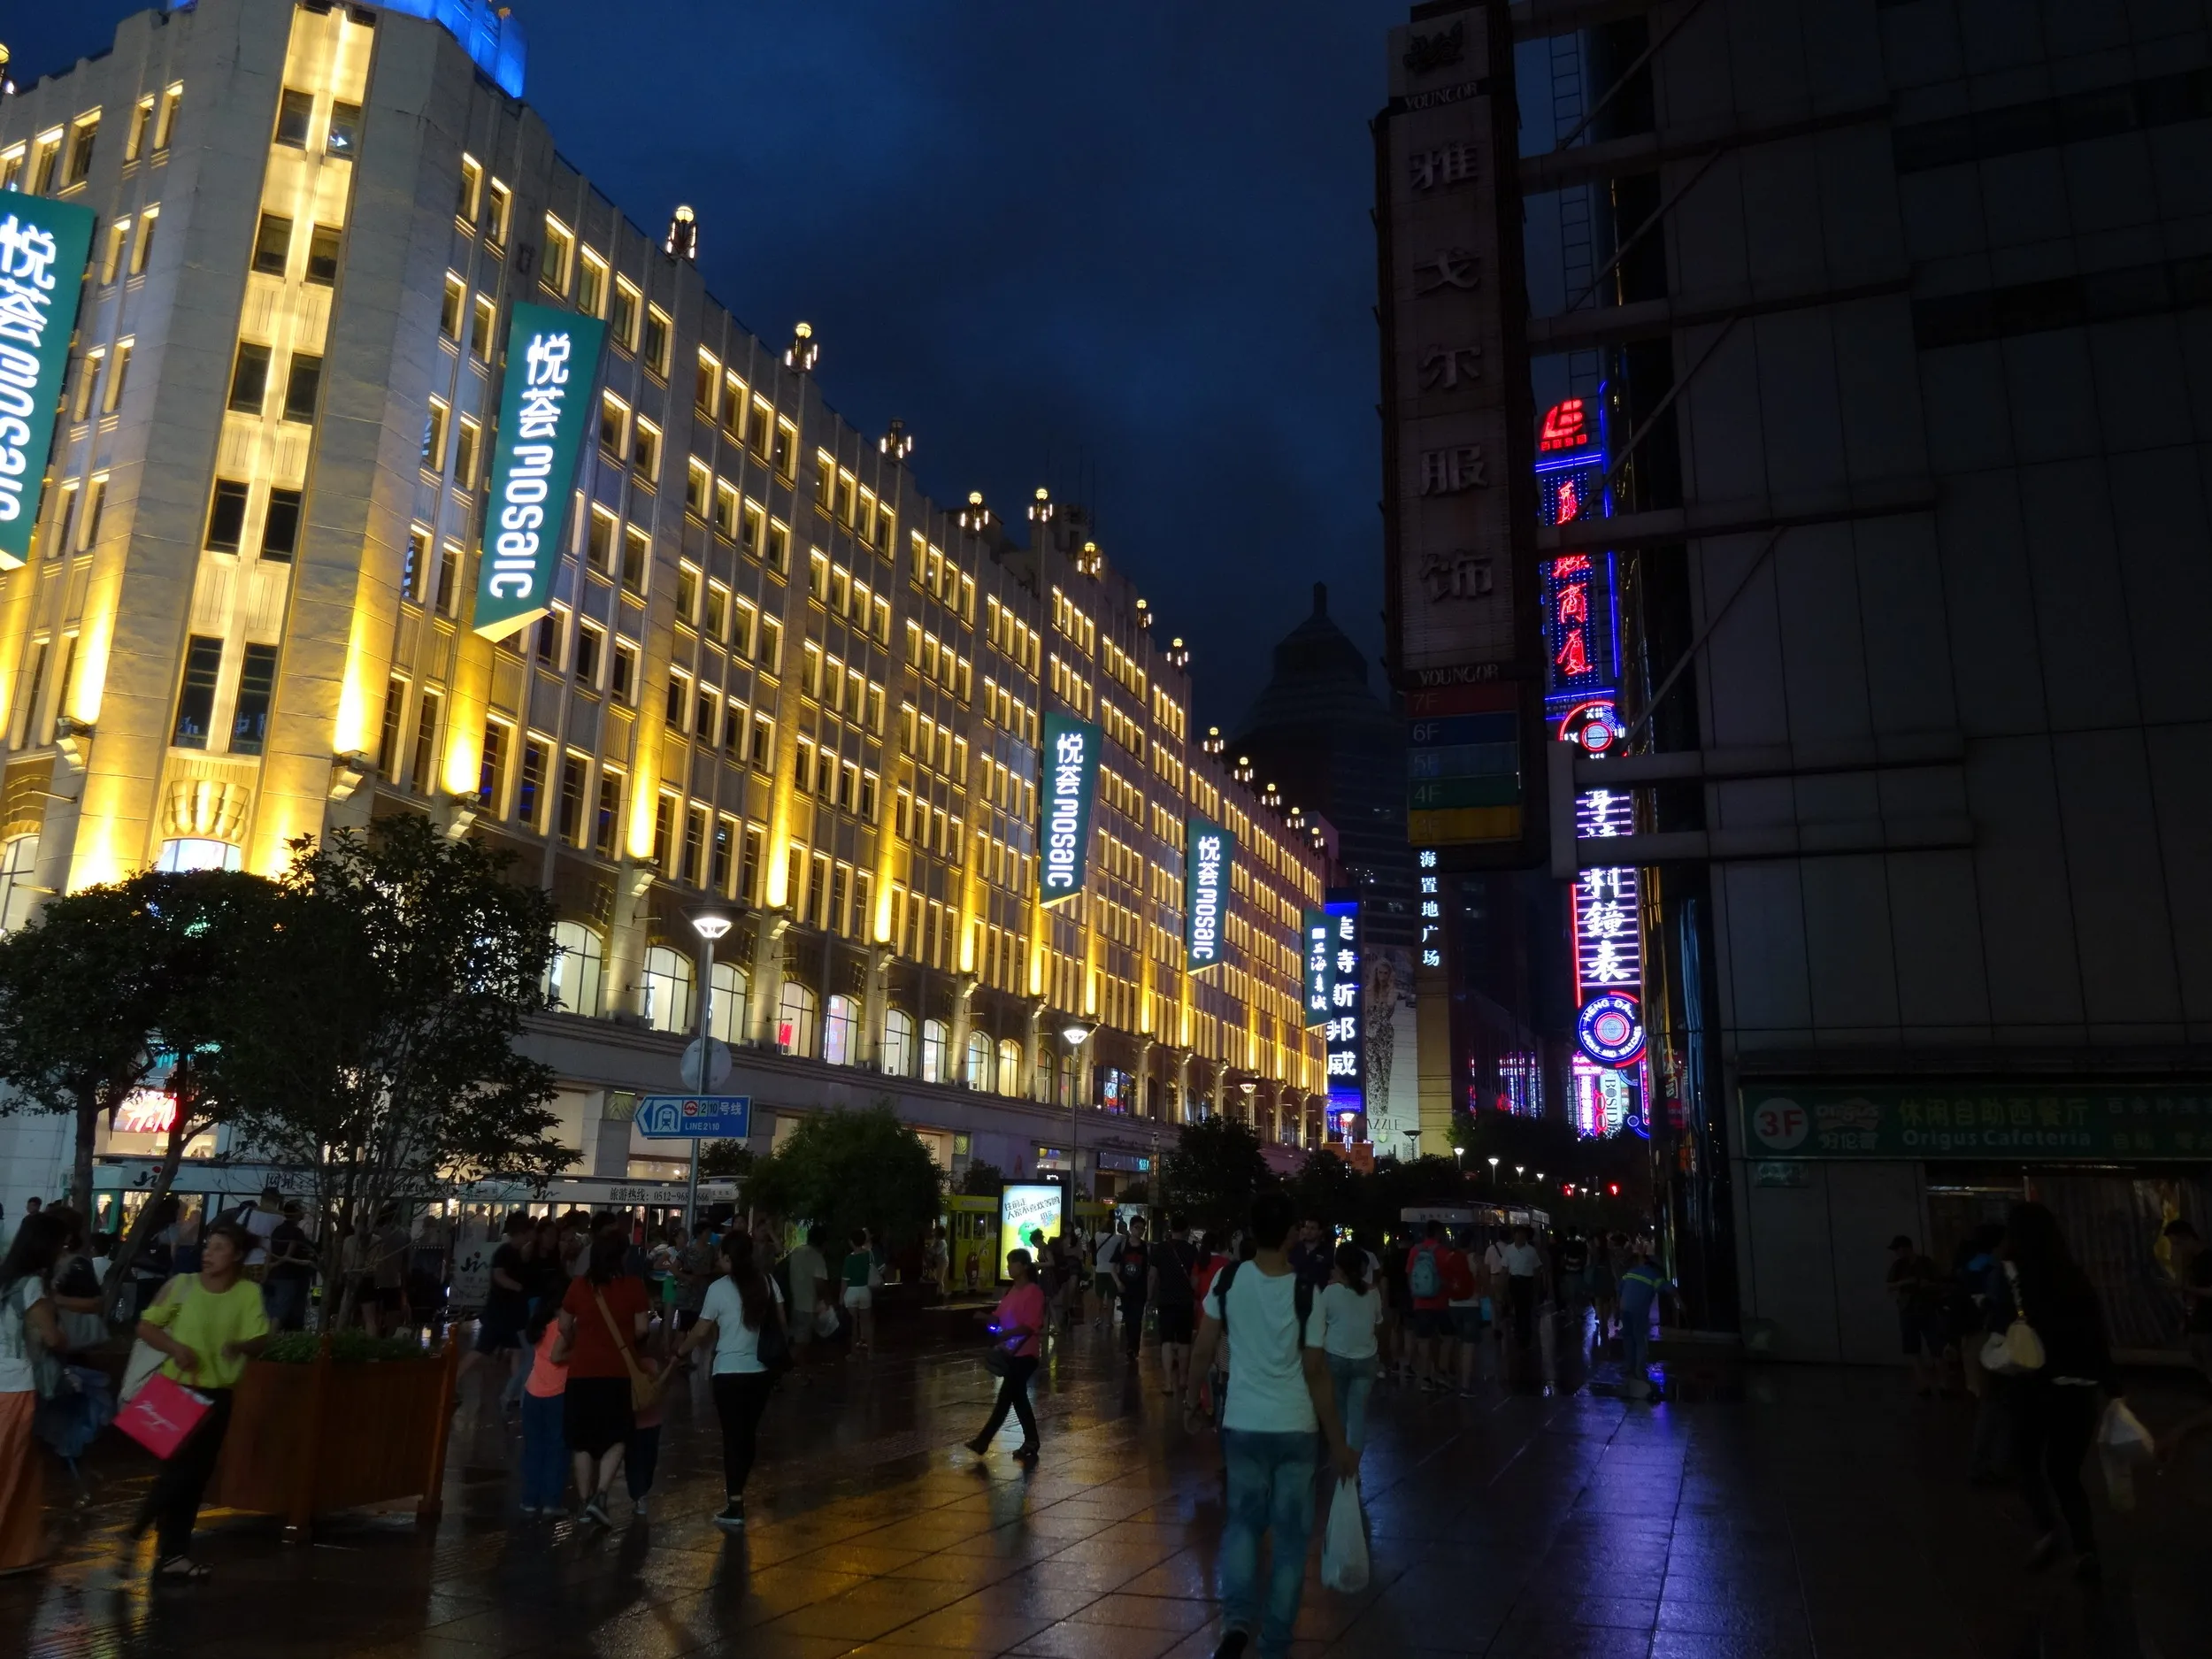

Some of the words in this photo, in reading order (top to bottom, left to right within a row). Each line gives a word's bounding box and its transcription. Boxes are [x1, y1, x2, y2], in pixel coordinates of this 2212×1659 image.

[1404, 81, 1479, 111] YOUNGOR
[518, 332, 572, 439] 悦荟
[1409, 141, 1494, 603] 雅戈尔服饰
[488, 444, 555, 599] mosaic
[1418, 663, 1500, 687] YOUNGOR
[1412, 693, 1441, 712] 7F
[1412, 722, 1440, 742] 6F
[1055, 733, 1084, 795] 悦荟
[1413, 753, 1440, 772] 5F
[1413, 783, 1442, 803] 4F
[1047, 798, 1079, 888] mosaic
[1197, 835, 1221, 886] 悦荟
[1419, 850, 1440, 967] 海置地广场
[1192, 887, 1218, 960] mosaic
[1582, 998, 1610, 1023] HENG
[1582, 1029, 1601, 1053] LOCKS
[701, 1102, 707, 1114] 2
[710, 1102, 718, 1114] 10
[719, 1102, 742, 1116] 号线
[1759, 1109, 1802, 1138] 3F
[1898, 1097, 2089, 1127] 休闲自助西餐厅
[1901, 1128, 1978, 1150] Origus
[1983, 1128, 2092, 1148] Cafeteria
